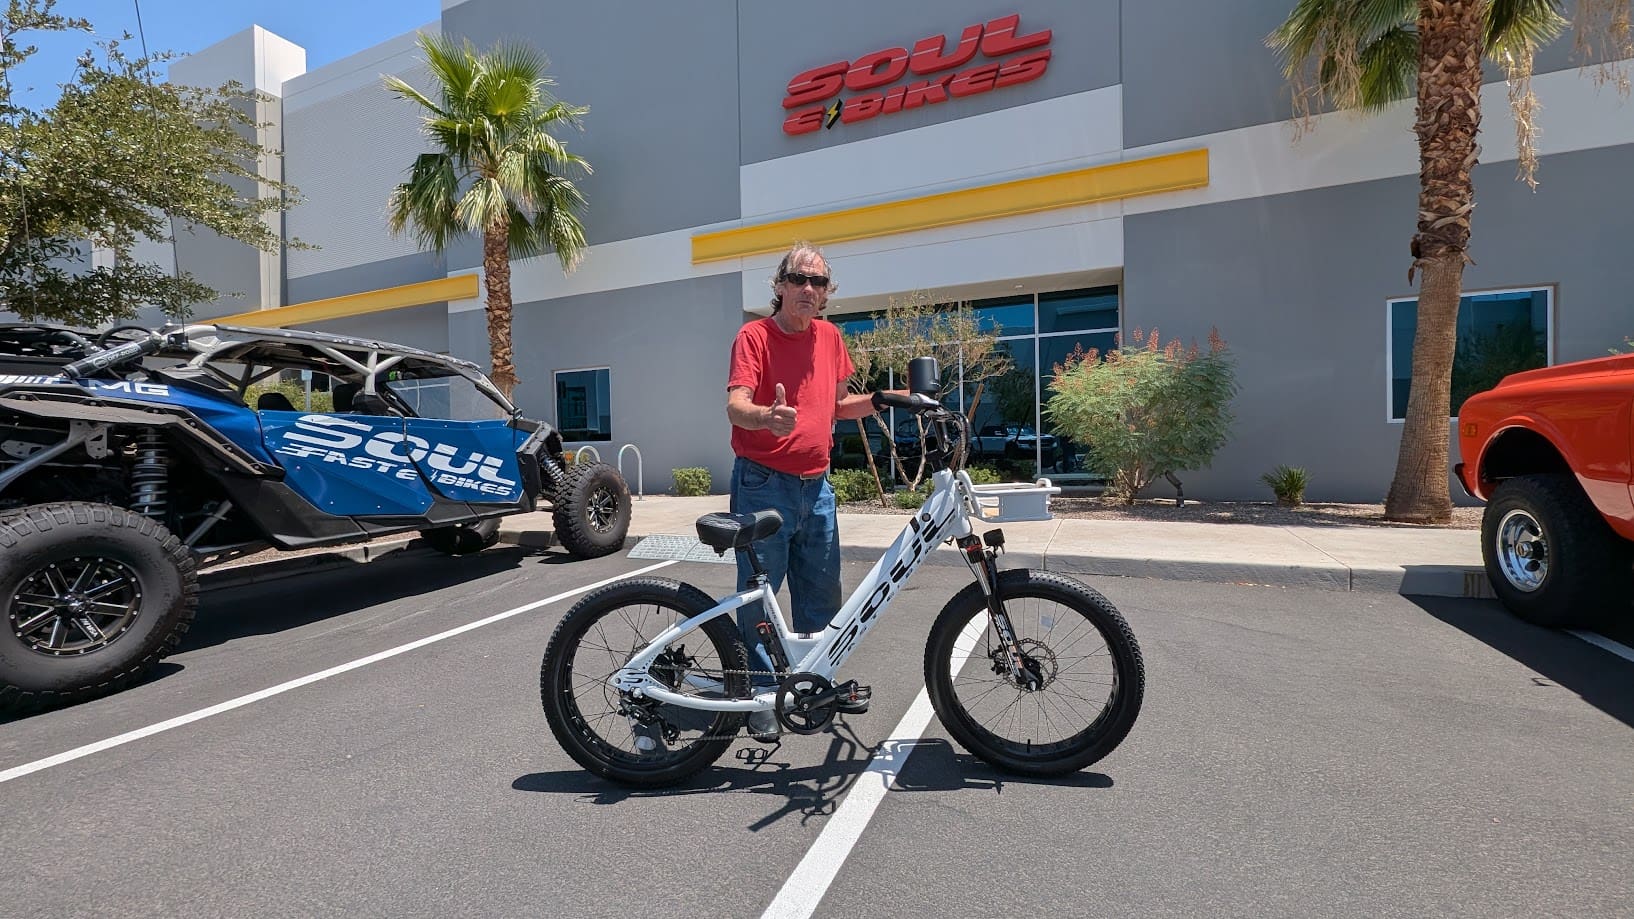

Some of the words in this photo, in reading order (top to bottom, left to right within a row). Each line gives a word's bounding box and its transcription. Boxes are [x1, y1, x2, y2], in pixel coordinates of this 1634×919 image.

[782, 13, 1052, 109] SOUL
[782, 105, 826, 136] E
[840, 48, 1051, 125] BIKES
[278, 443, 398, 474] FAST
[395, 468, 418, 481] E
[437, 473, 513, 496] BIKES
[282, 414, 516, 486] SOUL
[828, 508, 955, 667] SOUL
